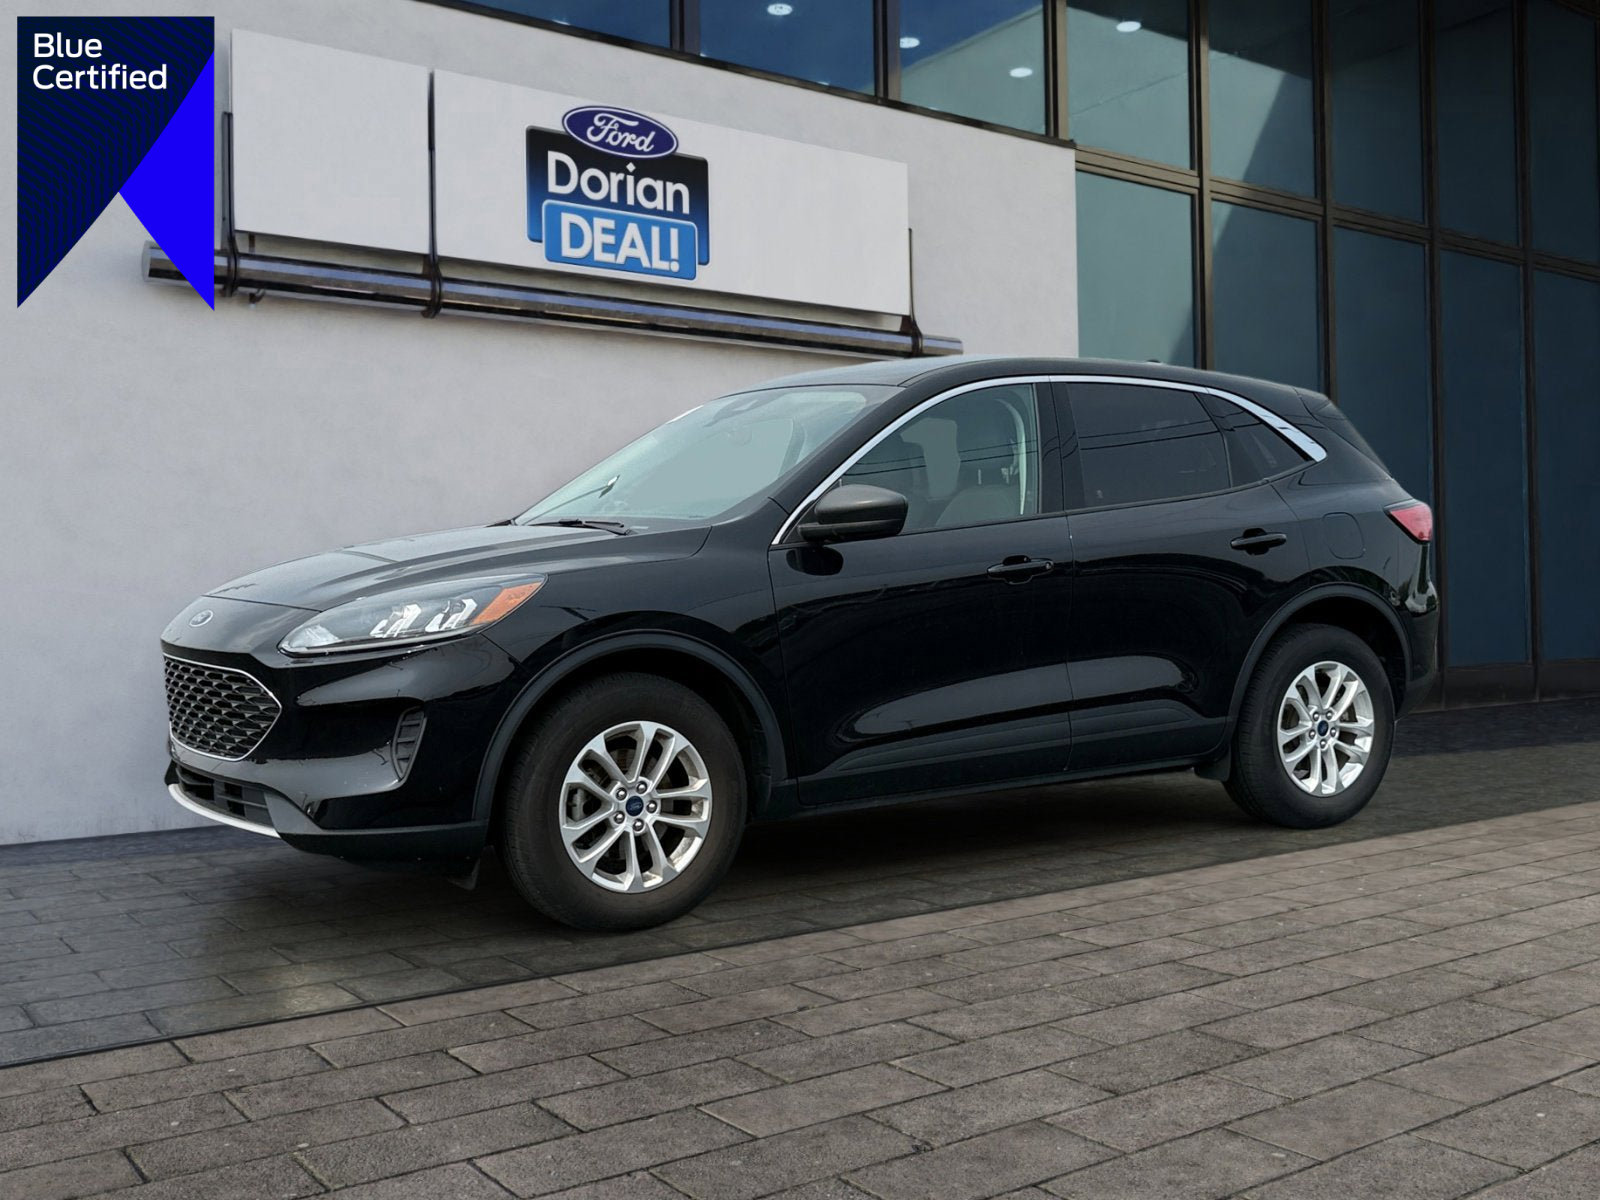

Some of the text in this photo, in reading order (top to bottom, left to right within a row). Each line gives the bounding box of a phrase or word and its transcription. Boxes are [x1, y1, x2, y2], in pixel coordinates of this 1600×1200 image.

[586, 112, 656, 152] Ford
[547, 150, 690, 215] Dorian
[560, 212, 680, 273] DEAL!
